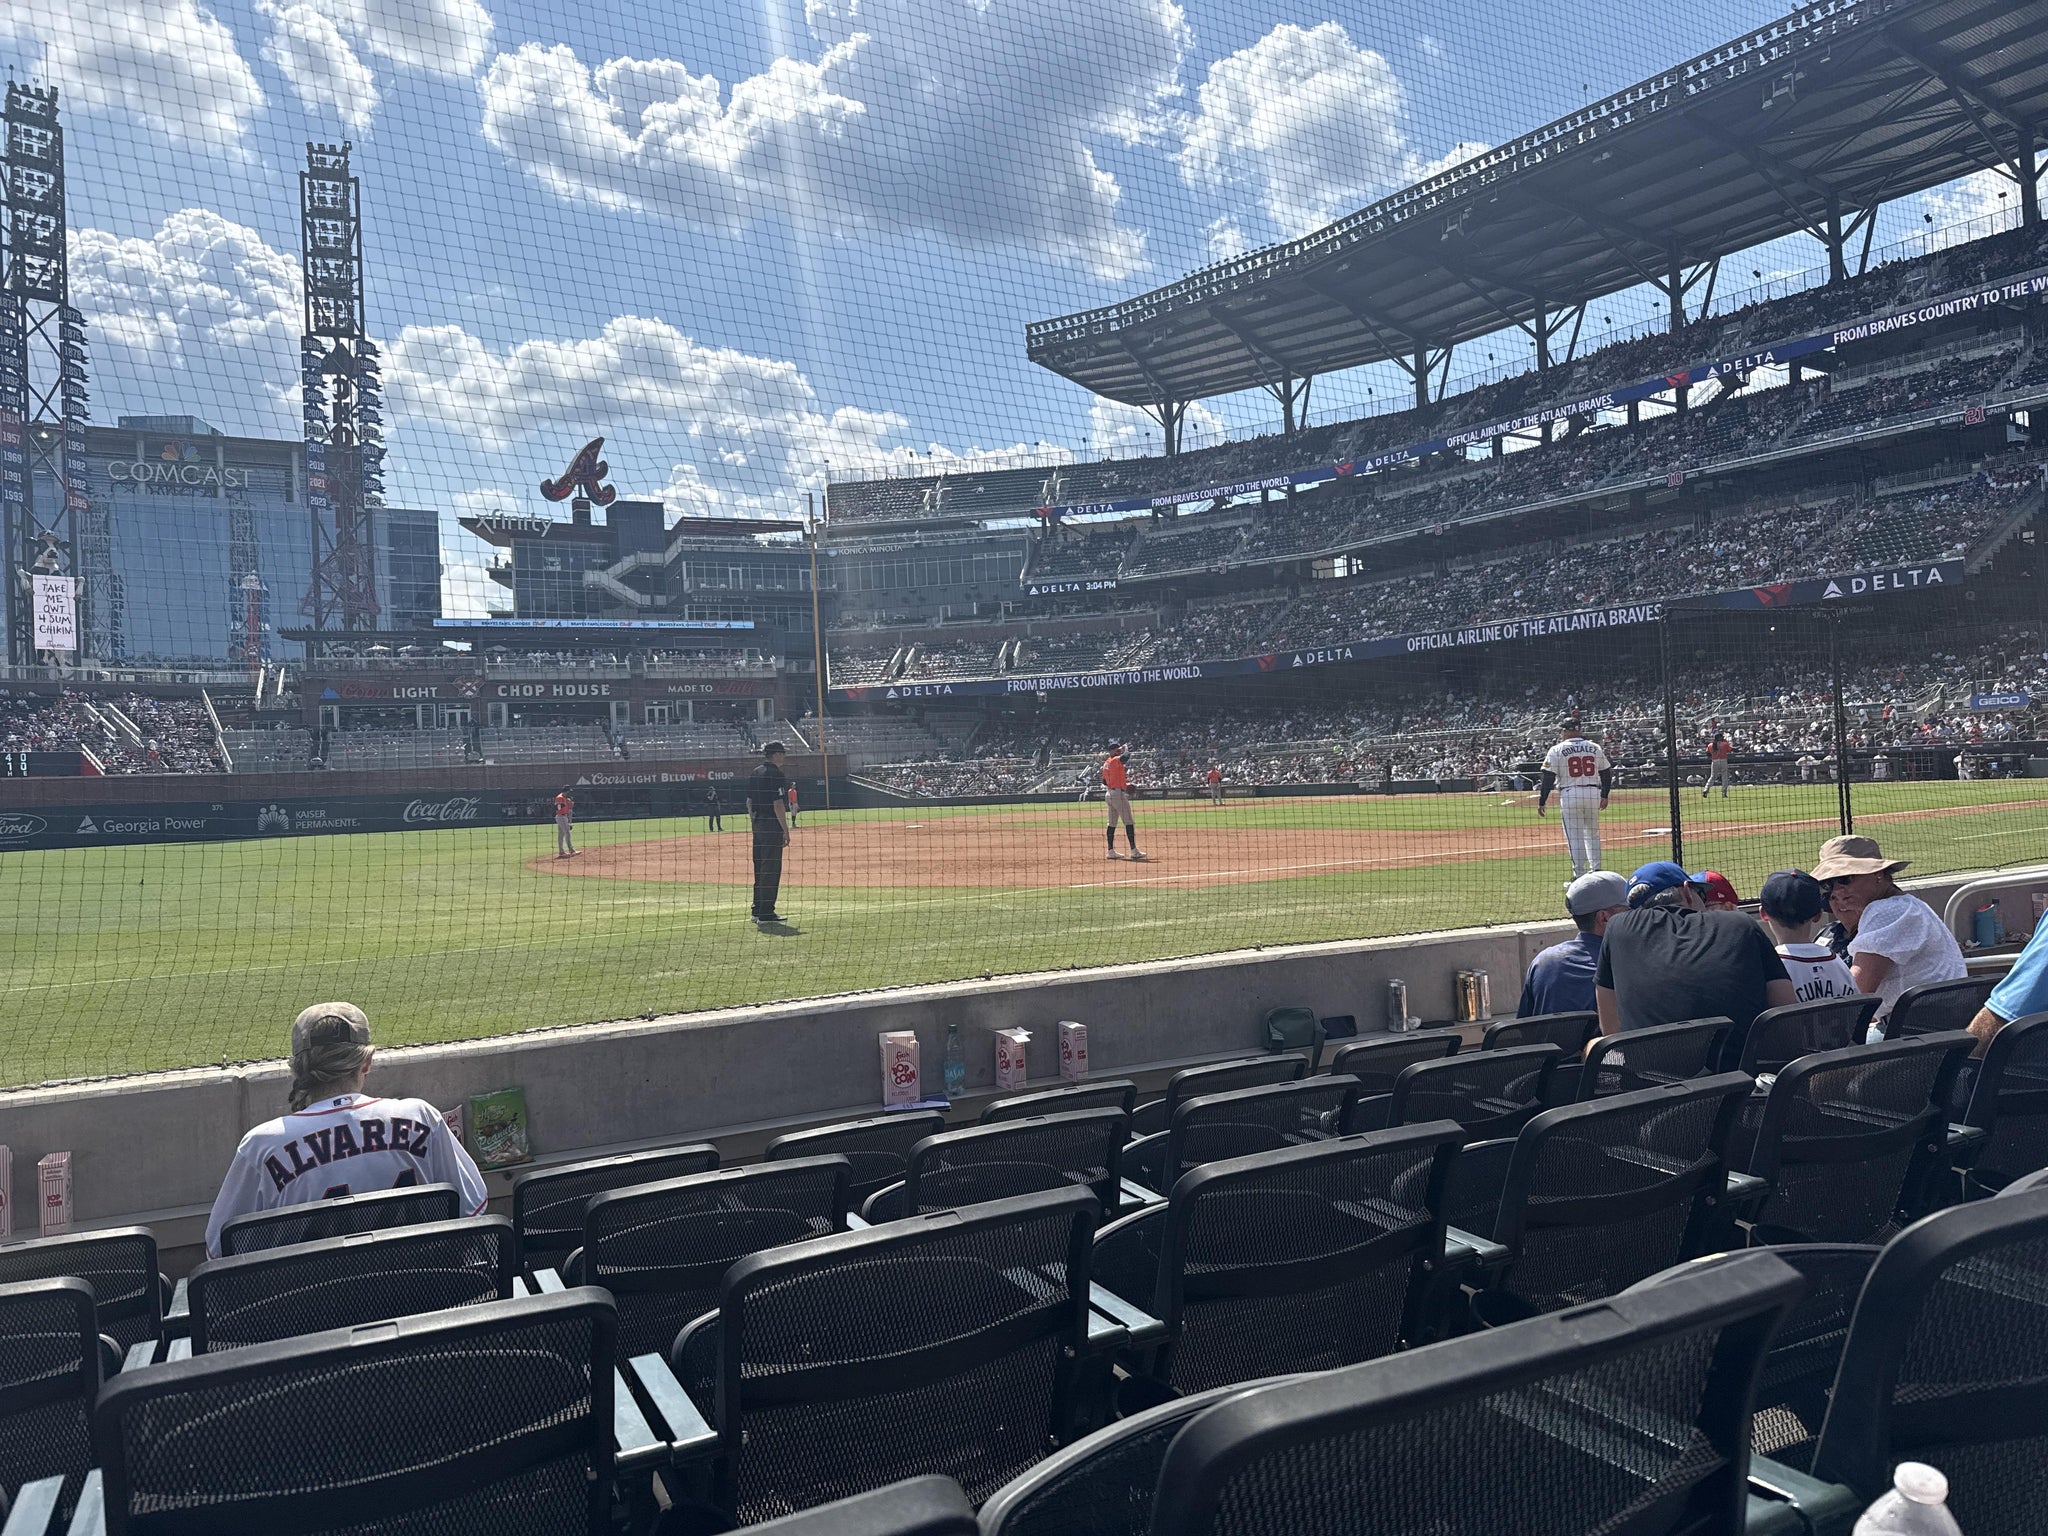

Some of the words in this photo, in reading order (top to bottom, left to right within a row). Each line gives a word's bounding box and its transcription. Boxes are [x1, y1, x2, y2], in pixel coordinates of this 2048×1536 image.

[1834, 324, 1868, 344] FROM
[1870, 312, 1917, 336] BRAVES
[1918, 294, 1980, 322] COUNTRY
[1981, 289, 2000, 306] TO
[2002, 282, 2030, 300] THE
[1723, 351, 1774, 373] DELTA
[1965, 406, 1985, 425] 21
[66, 421, 84, 434] 1948
[1447, 430, 1480, 448] OFFICIAL
[1480, 422, 1510, 441] AIRLINE
[1511, 420, 1522, 432] OF
[1523, 416, 1540, 429] THE
[1540, 404, 1577, 424] ATLANTA
[2, 432, 20, 444] 1957
[308, 443, 324, 454] 2013
[364, 446, 378, 455] 2018
[1376, 451, 1410, 466] DELTA
[4, 470, 22, 483] 1991
[108, 460, 254, 488] COMCAST
[1668, 471, 1683, 487] 10
[69, 478, 86, 490] 1992
[310, 478, 325, 488] 2021
[364, 480, 380, 490] 2022
[1152, 496, 1172, 508] FROM
[1172, 491, 1199, 504] BRAVES
[1200, 486, 1234, 500] COUNTRY
[1234, 483, 1245, 495] TO
[1246, 481, 1260, 494] THE
[310, 496, 326, 506] 2023
[1077, 503, 1113, 514] DELTA
[475, 508, 554, 538] xfinity
[839, 548, 868, 556] KONICA
[870, 545, 903, 554] MINOLTA
[1852, 567, 1943, 594] DELTA
[42, 584, 66, 592] TAKE
[1042, 584, 1080, 593] DELTA
[1086, 582, 1102, 590] 3:04
[1104, 581, 1116, 589] PM
[46, 594, 63, 603] ME
[39, 614, 46, 622] 4
[50, 615, 71, 624] SUM
[40, 625, 72, 634] CHIKIN
[1407, 630, 1454, 652] OFFICIAL
[1456, 624, 1501, 646] AIRLINE
[1504, 622, 1521, 639] OF
[1522, 618, 1546, 637] THE
[1548, 610, 1606, 634] ATLANTA
[1307, 647, 1353, 665] DELTA
[1008, 680, 1038, 692] FROM
[1040, 676, 1079, 690] BRAVES
[1081, 674, 1126, 688] COUNTRY
[1127, 672, 1140, 683] TO
[1142, 670, 1161, 682] THE
[1162, 666, 1202, 680] WORLD.
[394, 687, 437, 698] LIGHT
[498, 684, 545, 696] CHOP
[552, 684, 610, 696] HOUSE
[668, 684, 697, 693] MADE
[699, 684, 713, 693] TO
[902, 685, 952, 696] DELTA
[1979, 696, 2020, 706] GEICO
[1562, 746, 1597, 757] GONZALEZ
[5, 754, 12, 762] 4
[20, 754, 26, 762] 0
[20, 762, 27, 770] 0
[1568, 756, 1595, 777] 86
[591, 772, 626, 785] Coors
[628, 774, 657, 784] LIGHT
[708, 771, 734, 780] CHOP
[296, 810, 326, 819] KAISER
[403, 796, 481, 822] Coca-Cola
[103, 817, 160, 834] Georgia
[165, 816, 207, 830] Power
[296, 818, 358, 829] PERMANENTE
[892, 1064, 910, 1077] POP
[895, 1070, 916, 1085] CORN
[478, 1123, 519, 1145] Peanuts
[265, 1118, 431, 1193] ALVAREZ
